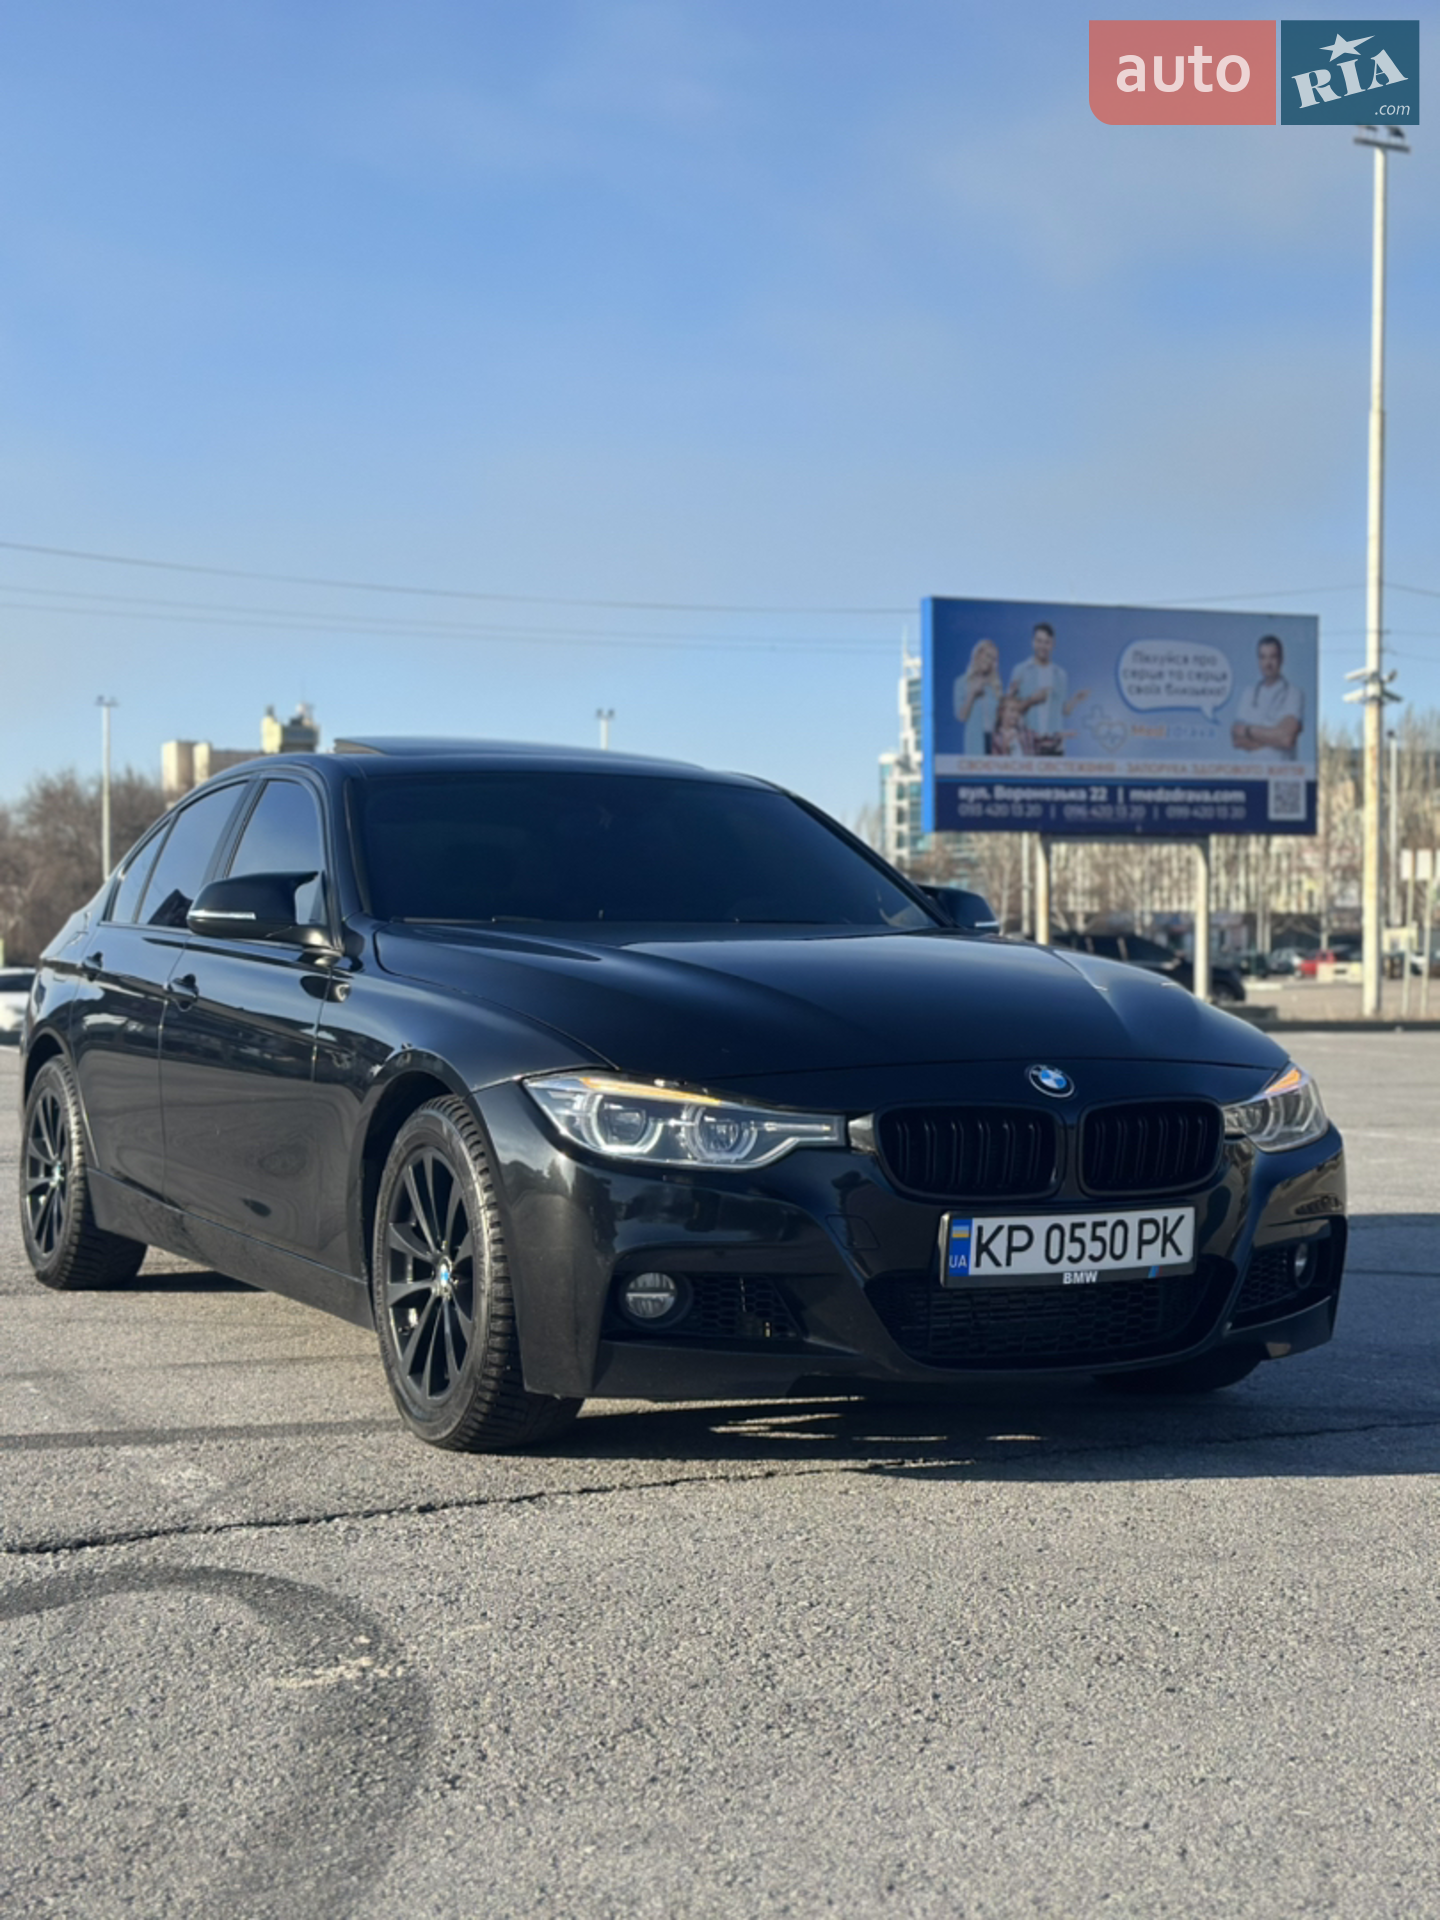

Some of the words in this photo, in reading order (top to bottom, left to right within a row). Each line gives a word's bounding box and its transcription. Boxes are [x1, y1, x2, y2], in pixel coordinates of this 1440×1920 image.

[974, 1224, 1034, 1268] KP
[1044, 1219, 1129, 1265] 0550
[1136, 1214, 1185, 1260] PK
[949, 1255, 968, 1269] UA
[1063, 1271, 1098, 1284] BMW
